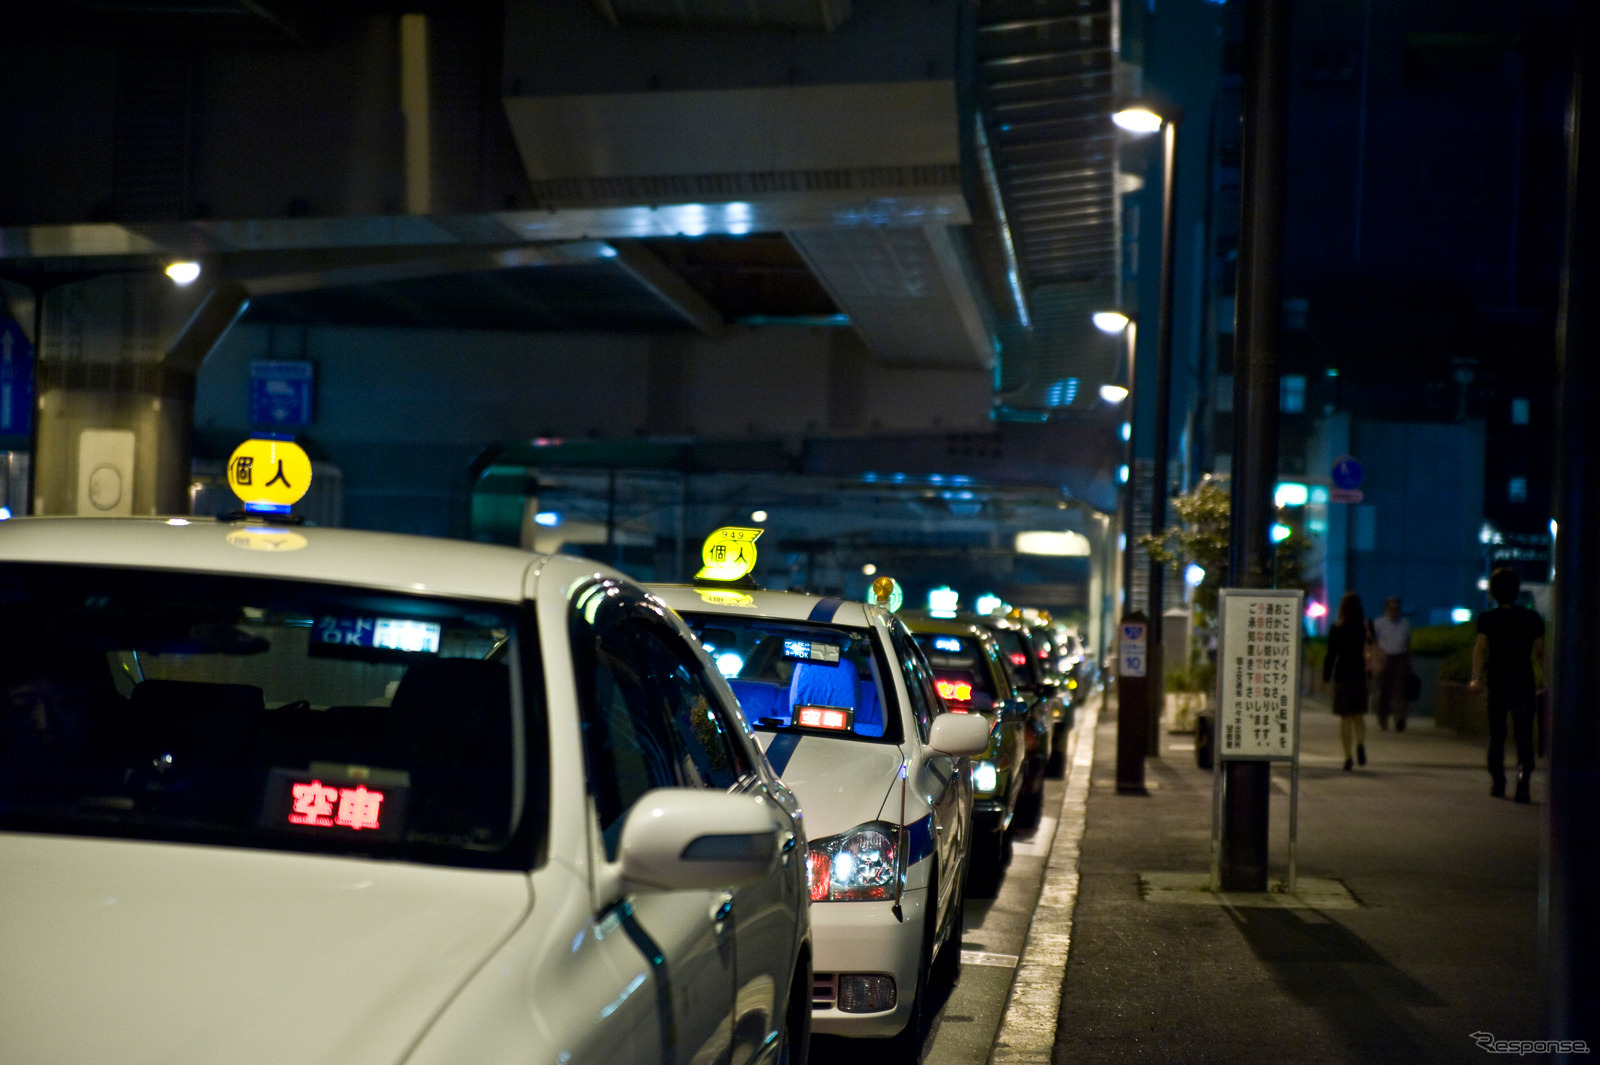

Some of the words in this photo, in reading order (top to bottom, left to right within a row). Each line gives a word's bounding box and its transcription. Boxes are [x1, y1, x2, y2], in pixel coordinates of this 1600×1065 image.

[229, 456, 291, 488] 個人
[721, 531, 744, 540] 949
[709, 545, 748, 564] 個人
[322, 630, 362, 646] OK
[1126, 657, 1141, 670] 10
[288, 779, 384, 829] 空車
